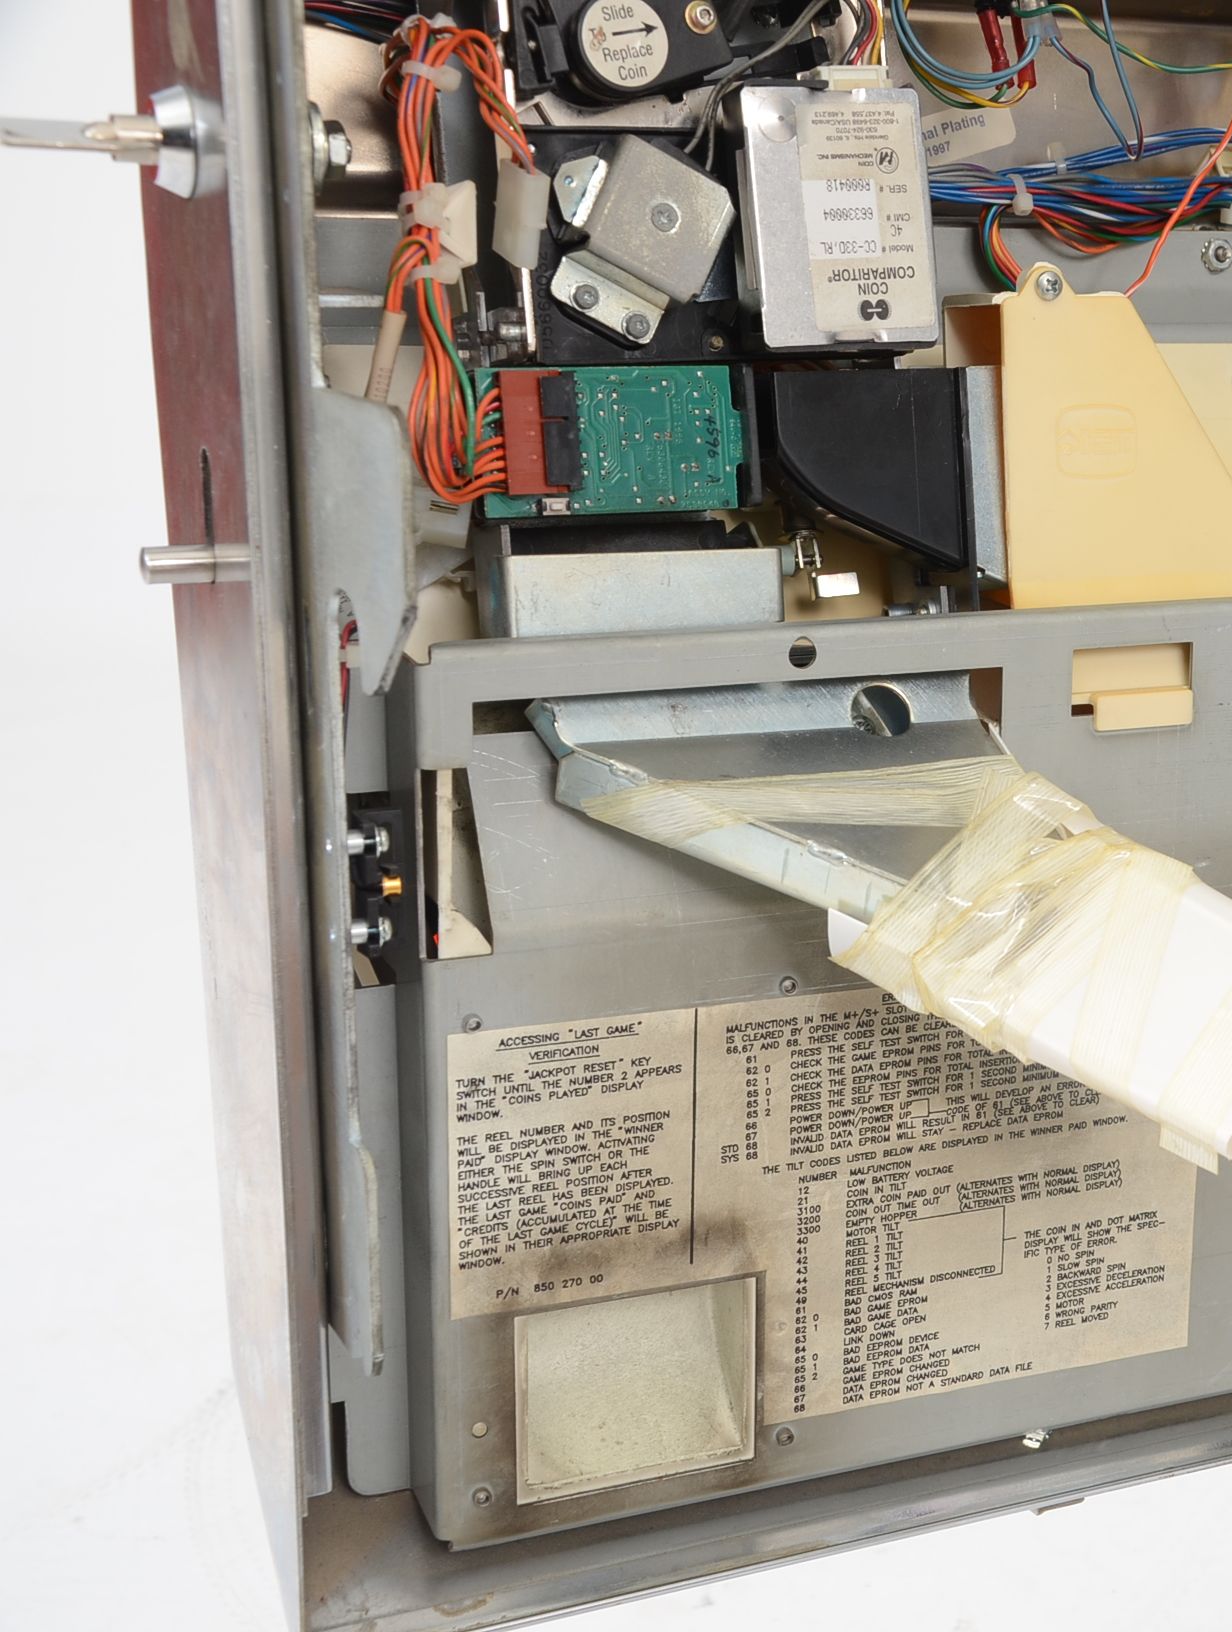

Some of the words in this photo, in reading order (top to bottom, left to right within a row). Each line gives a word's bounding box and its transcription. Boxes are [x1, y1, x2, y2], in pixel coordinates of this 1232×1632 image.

[602, 4, 634, 21] Slide
[602, 43, 653, 62] Replace
[618, 64, 648, 80] Coin
[941, 114, 986, 135] Plating
[831, 153, 874, 162] MECHANISMS
[927, 141, 951, 156] 1997
[888, 184, 908, 193] SER.
[890, 224, 903, 237] 4C
[894, 213, 911, 222] CMI
[890, 244, 914, 253] Model
[857, 283, 889, 295] COIN
[498, 1032, 559, 1047] ACCESSING
[569, 1027, 599, 1039] "LAST
[606, 1021, 642, 1035] GAME"
[726, 1016, 798, 1034] MALFUNCTIONS
[804, 1015, 813, 1024] IN
[819, 1012, 837, 1022] THE
[843, 1008, 879, 1020] M+/S+
[528, 1044, 599, 1060] VERIFICATION
[455, 1076, 485, 1088] TURN
[492, 1072, 514, 1084] THE
[524, 1065, 576, 1080] "JACKPOT
[583, 1059, 623, 1073] RESET"
[630, 1056, 651, 1067] KEY
[456, 1087, 496, 1100] SWITCH
[503, 1083, 534, 1094] UNTIL
[541, 1078, 562, 1089] THE
[568, 1072, 614, 1086] NUMBER
[634, 1063, 682, 1078] APPEARS
[456, 1109, 502, 1122] WINDOW.
[456, 1134, 477, 1145] THE
[485, 1131, 513, 1142] REEL
[519, 1123, 565, 1138] NUMBER
[571, 1120, 593, 1131] AND
[600, 1117, 615, 1127] ITS
[623, 1110, 670, 1124] POSITION
[456, 1146, 481, 1157] WILL
[488, 1142, 502, 1153] BE
[510, 1134, 567, 1151] DISPLAYED
[574, 1132, 585, 1142] IN
[591, 1128, 612, 1139] THE
[617, 1121, 663, 1134] "WINNER
[457, 1156, 485, 1168] PAID"
[494, 1149, 538, 1164] DISPLAY
[544, 1143, 590, 1156] WINDOW.
[597, 1133, 655, 1150] ACTIVATING
[761, 1164, 780, 1175] THE
[785, 1160, 804, 1171] TILT
[809, 1156, 841, 1168] CODES
[846, 1150, 877, 1163] LISTED
[882, 1145, 913, 1158] BELOW
[918, 1142, 936, 1152] ARE
[941, 1135, 988, 1149] DISPLAYED
[994, 1133, 1003, 1141] IN
[1008, 1129, 1025, 1139] THE
[1030, 1124, 1063, 1136] WINNER
[1068, 1120, 1087, 1131] PAID
[1092, 1115, 1127, 1126] WINDOW.
[457, 1185, 525, 1203] SUCCESSIVE
[531, 1181, 559, 1193] REEL
[565, 1173, 613, 1188] POSITION
[620, 1167, 652, 1180] AFTER
[458, 1177, 500, 1192] HANDLE
[507, 1173, 531, 1184] WILL
[538, 1167, 570, 1181] BRING
[577, 1164, 592, 1175] UP
[600, 1160, 627, 1172] EACH
[798, 1170, 837, 1184] NUMBER
[849, 1160, 911, 1176] MALFUNCTION
[798, 1185, 809, 1195] 12
[847, 1177, 866, 1188] LOW
[871, 1170, 910, 1184] BATTERY
[914, 1164, 953, 1178] VOLTAGE
[457, 1221, 508, 1236] "CREDITS
[516, 1208, 596, 1230] (ACCUMULATED
[603, 1205, 616, 1216] AT
[621, 1201, 642, 1213] THE
[648, 1197, 671, 1209] TIME
[796, 1224, 820, 1236] 3300
[845, 1215, 875, 1228] EMPTY
[880, 1209, 917, 1223] HOPPER
[959, 1194, 1016, 1211] (ALTERNATES
[1020, 1190, 1041, 1200] WITH
[1046, 1185, 1080, 1197] NORMAL
[1085, 1177, 1122, 1191] DISPLAY)
[458, 1238, 473, 1249] OF
[479, 1233, 500, 1245] THE
[507, 1228, 533, 1241] LAST
[539, 1223, 568, 1236] GAME
[575, 1215, 617, 1231] CYCLE)"
[625, 1212, 648, 1223] WILL
[654, 1209, 669, 1219] BE
[1023, 1228, 1041, 1239] THE
[1045, 1225, 1066, 1236] COIN
[1071, 1223, 1080, 1232] IN
[1084, 1219, 1102, 1229] AND
[1107, 1215, 1124, 1226] DOT
[1128, 1210, 1157, 1222] MATRIX
[459, 1245, 497, 1260] SHOWN
[504, 1242, 515, 1252] IN
[522, 1237, 553, 1249] THEIR
[559, 1225, 631, 1244] APPROPRIATE
[637, 1218, 679, 1233] DISPLAY
[458, 1256, 504, 1270] WINDOW.
[495, 1286, 519, 1298] P/N
[533, 1281, 554, 1292] 850
[561, 1277, 582, 1288] 270
[589, 1273, 603, 1284] 00
[844, 1286, 867, 1297] REEL
[872, 1276, 924, 1292] MECHANISM
[929, 1264, 995, 1283] DISCONNECTED
[1056, 1275, 1101, 1290] EXCESSIVE
[1105, 1265, 1165, 1282] DECELERATION
[794, 1334, 806, 1344] 63
[843, 1324, 867, 1335] CARD
[873, 1318, 896, 1331] CAGE
[901, 1314, 926, 1325] OPEN
[793, 1393, 805, 1403] 67
[842, 1383, 864, 1395] DATA
[869, 1377, 900, 1389] EPROM
[906, 1368, 948, 1382] CHANGED
